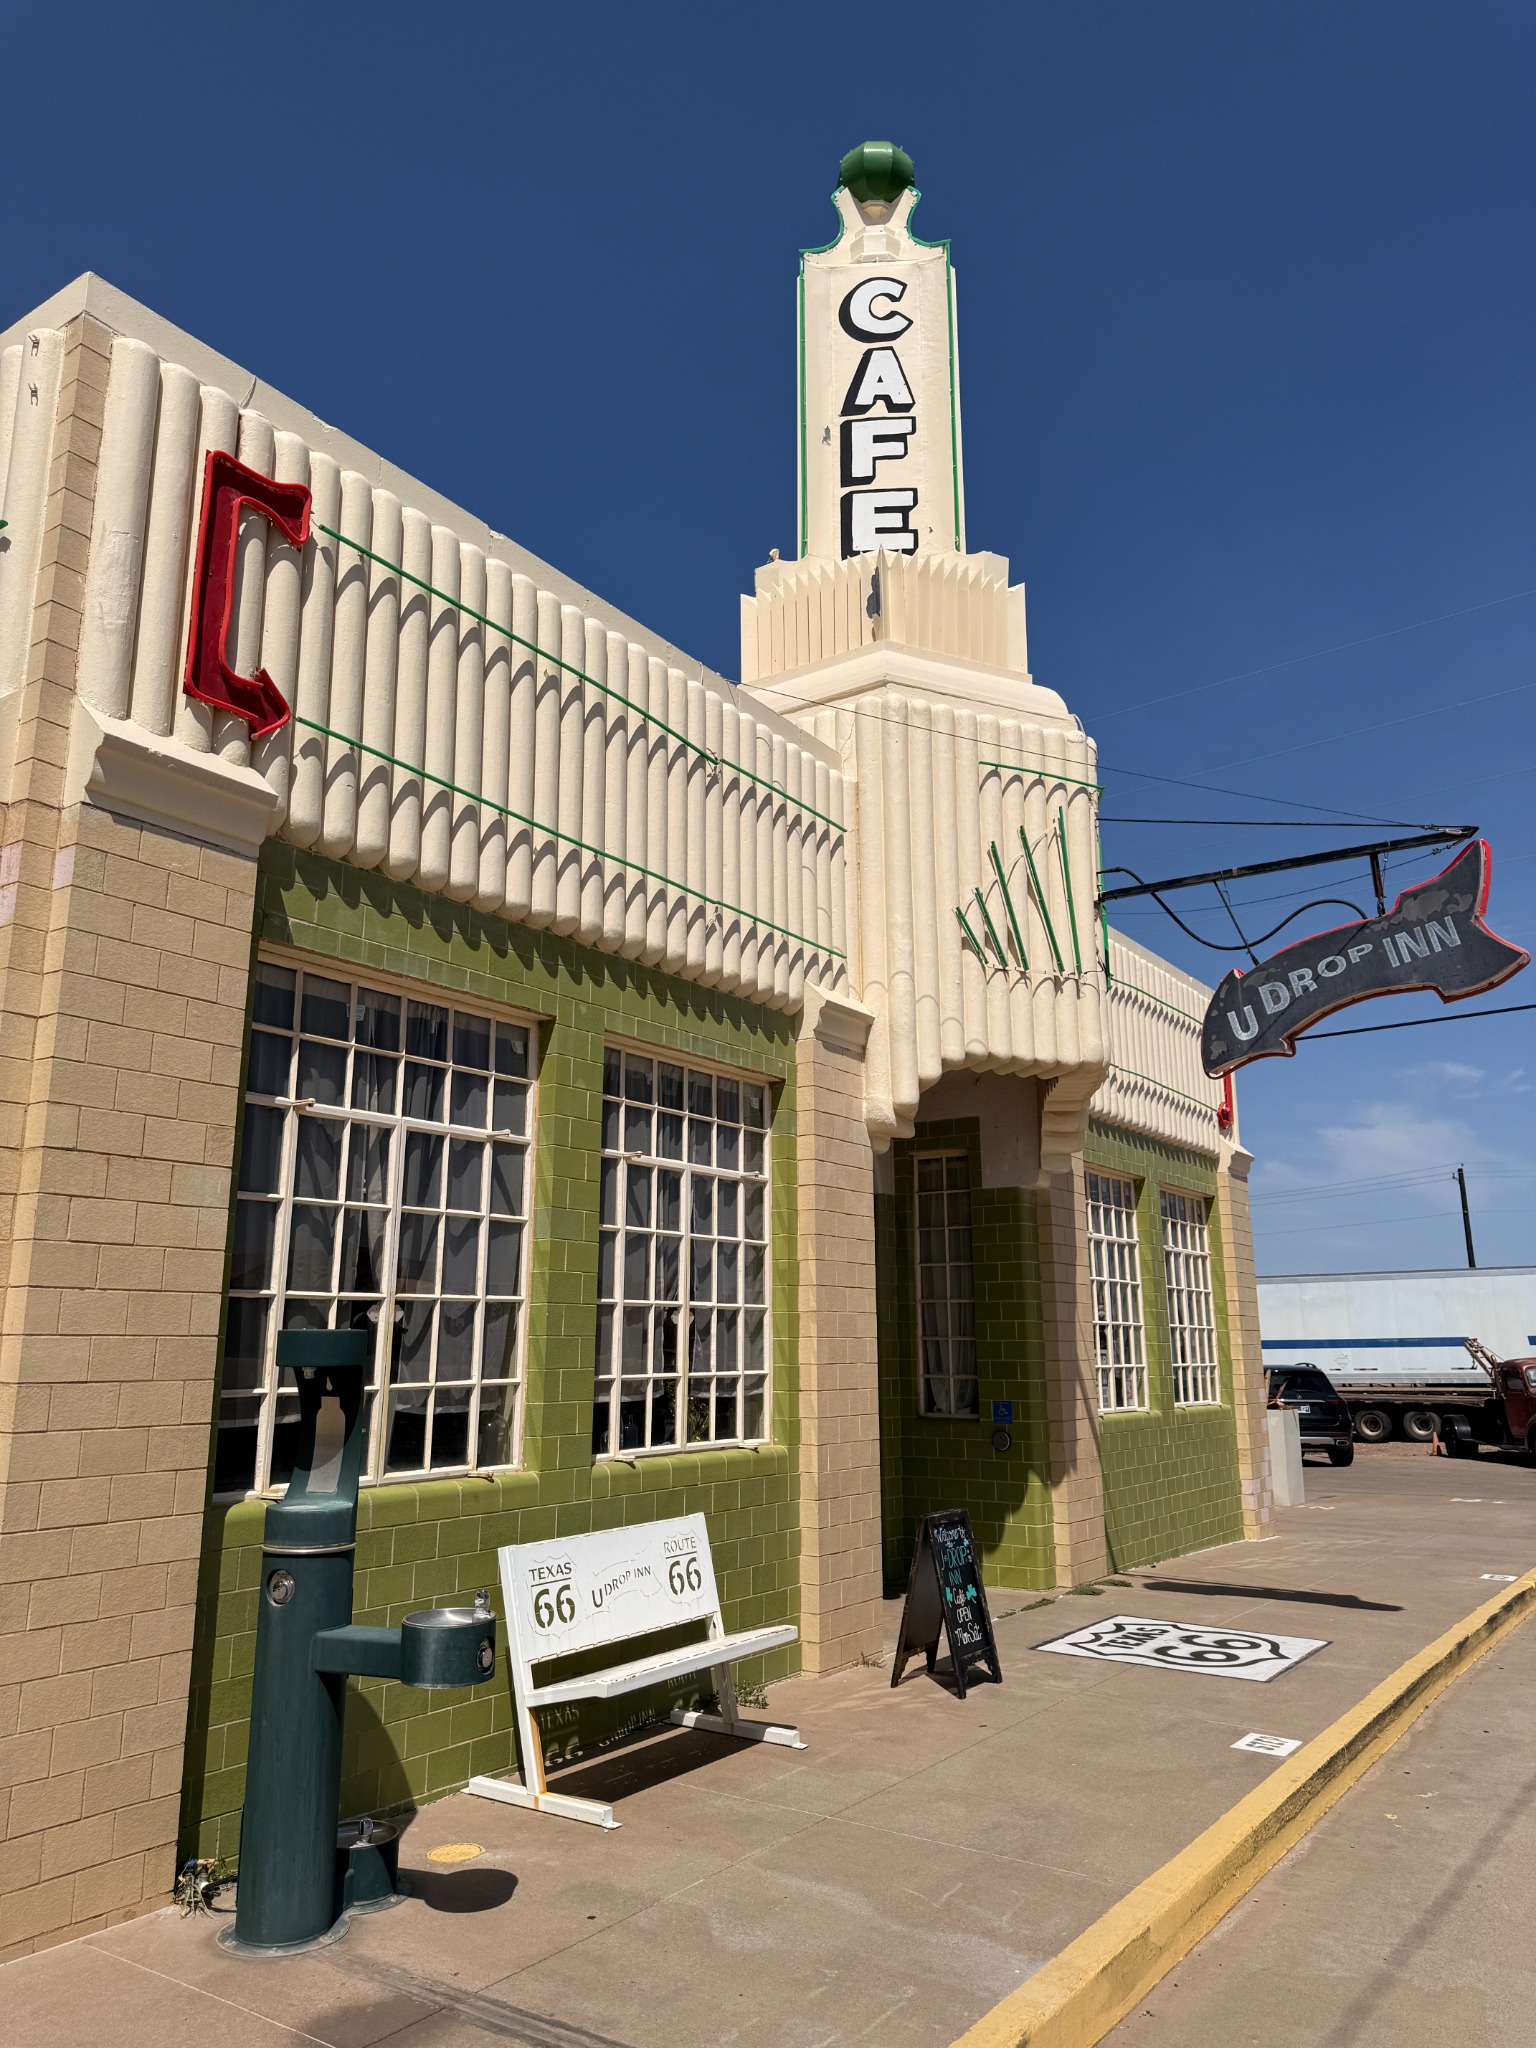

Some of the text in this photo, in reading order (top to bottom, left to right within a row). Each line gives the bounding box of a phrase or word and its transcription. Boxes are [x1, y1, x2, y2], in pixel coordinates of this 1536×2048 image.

[838, 276, 918, 560] CAFE
[1226, 915, 1461, 1041] U DROP INN
[664, 1536, 696, 1553] ROUTE
[529, 1562, 572, 1582] TEXAS
[669, 1556, 702, 1596] 66
[949, 1568, 962, 1586] INN
[592, 1565, 651, 1608] U DROP INN
[534, 1584, 575, 1629] 66
[957, 1606, 972, 1623] OPEN
[1097, 1627, 1170, 1649] TEXAS
[1154, 1635, 1262, 1662] 66
[1245, 1736, 1289, 1750] STEP
